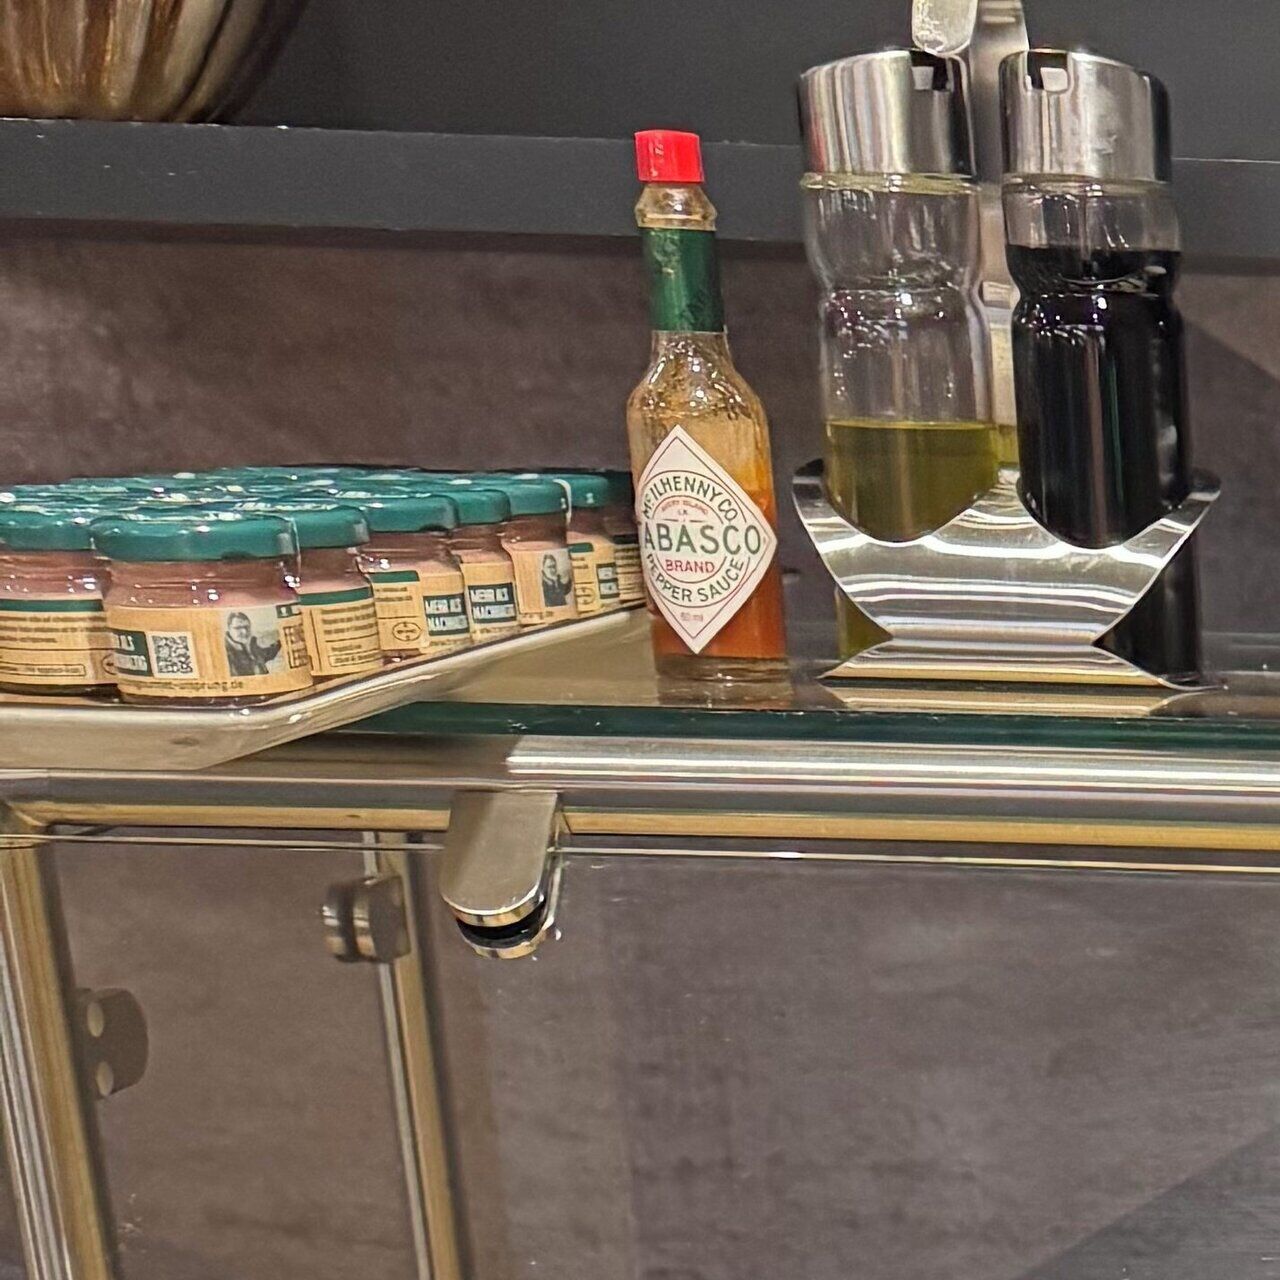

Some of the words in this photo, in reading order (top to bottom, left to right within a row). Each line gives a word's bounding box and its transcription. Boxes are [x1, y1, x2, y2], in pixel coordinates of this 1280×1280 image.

[644, 522, 761, 556] ABASCO
[646, 553, 693, 603] PEPPER
[697, 557, 745, 603] SAUCE
[665, 559, 716, 574] BRAND
